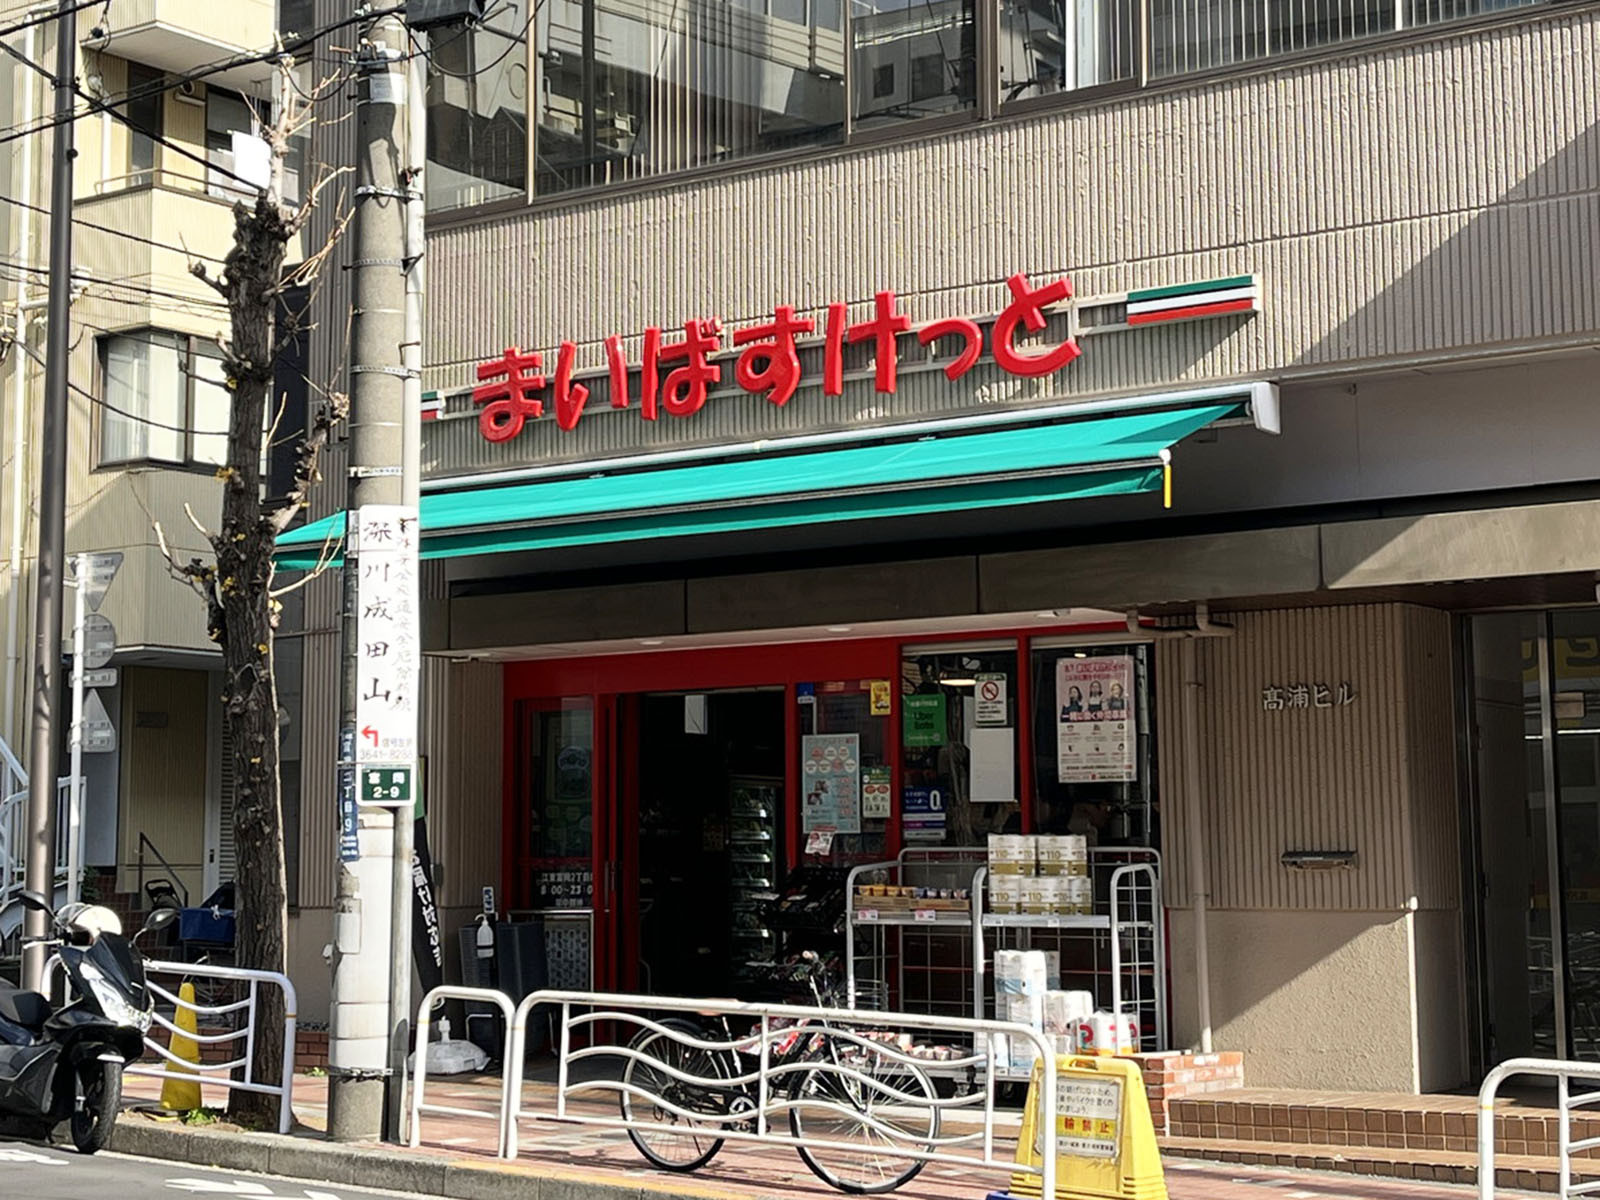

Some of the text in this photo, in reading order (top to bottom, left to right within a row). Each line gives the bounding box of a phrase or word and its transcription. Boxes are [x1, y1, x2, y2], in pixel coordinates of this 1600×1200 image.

[472, 271, 1082, 443] まいばすけっと
[362, 521, 393, 702] 深川成田山
[372, 785, 400, 798] 2-9
